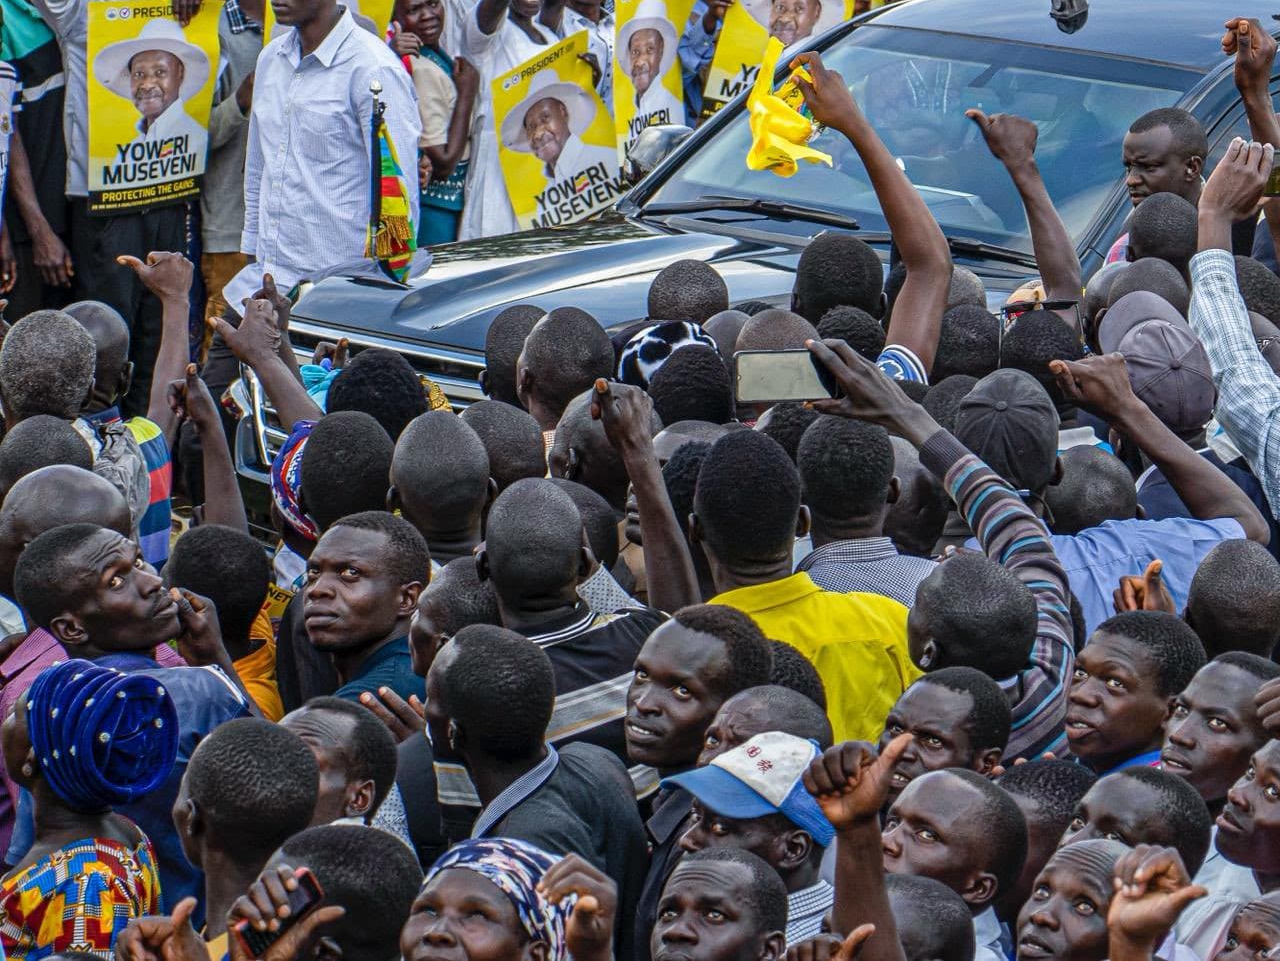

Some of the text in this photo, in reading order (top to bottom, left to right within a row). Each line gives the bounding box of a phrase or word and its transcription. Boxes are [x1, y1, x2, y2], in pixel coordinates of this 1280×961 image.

[520, 46, 565, 80] PRESIDENT
[116, 134, 189, 163] YOWERI
[103, 153, 197, 185] MUSEVENI
[102, 186, 157, 202] PROTECTING
[158, 184, 173, 195] THE
[173, 179, 194, 191] GAINS
[534, 161, 609, 212] YOWERI
